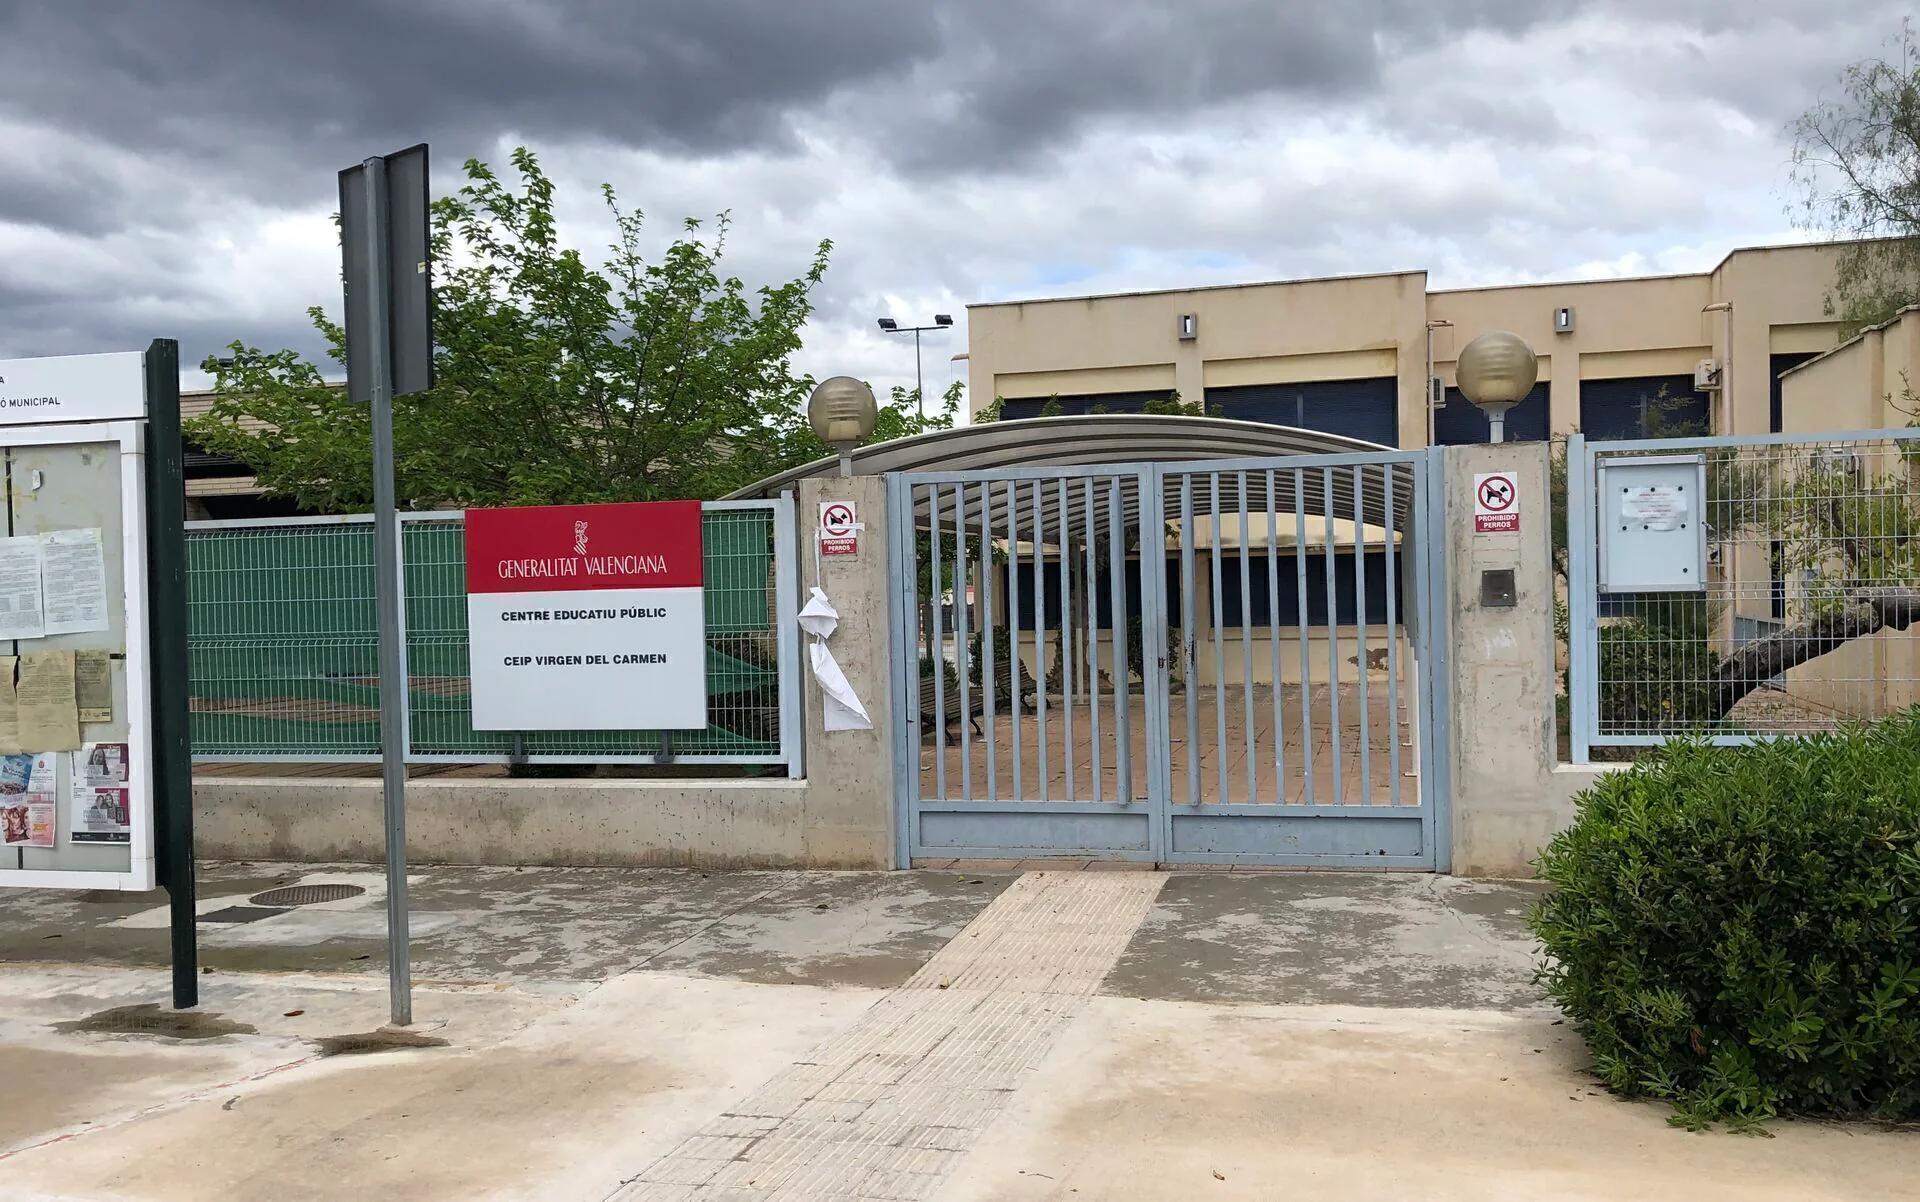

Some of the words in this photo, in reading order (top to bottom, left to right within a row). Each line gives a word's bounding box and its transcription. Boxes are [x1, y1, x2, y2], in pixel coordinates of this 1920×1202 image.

[9, 397, 61, 407] MUNICIPAL
[498, 557, 578, 578] GENERALITAT
[584, 555, 667, 575] VALENCIANA
[501, 611, 550, 621] CENTRE
[554, 609, 616, 620] EDUCATIU
[620, 606, 667, 618] PÚBLIC
[504, 656, 532, 666] CEIP
[536, 655, 582, 665] VIRGEN
[586, 655, 609, 665] DEL
[613, 654, 667, 664] CARMEN
